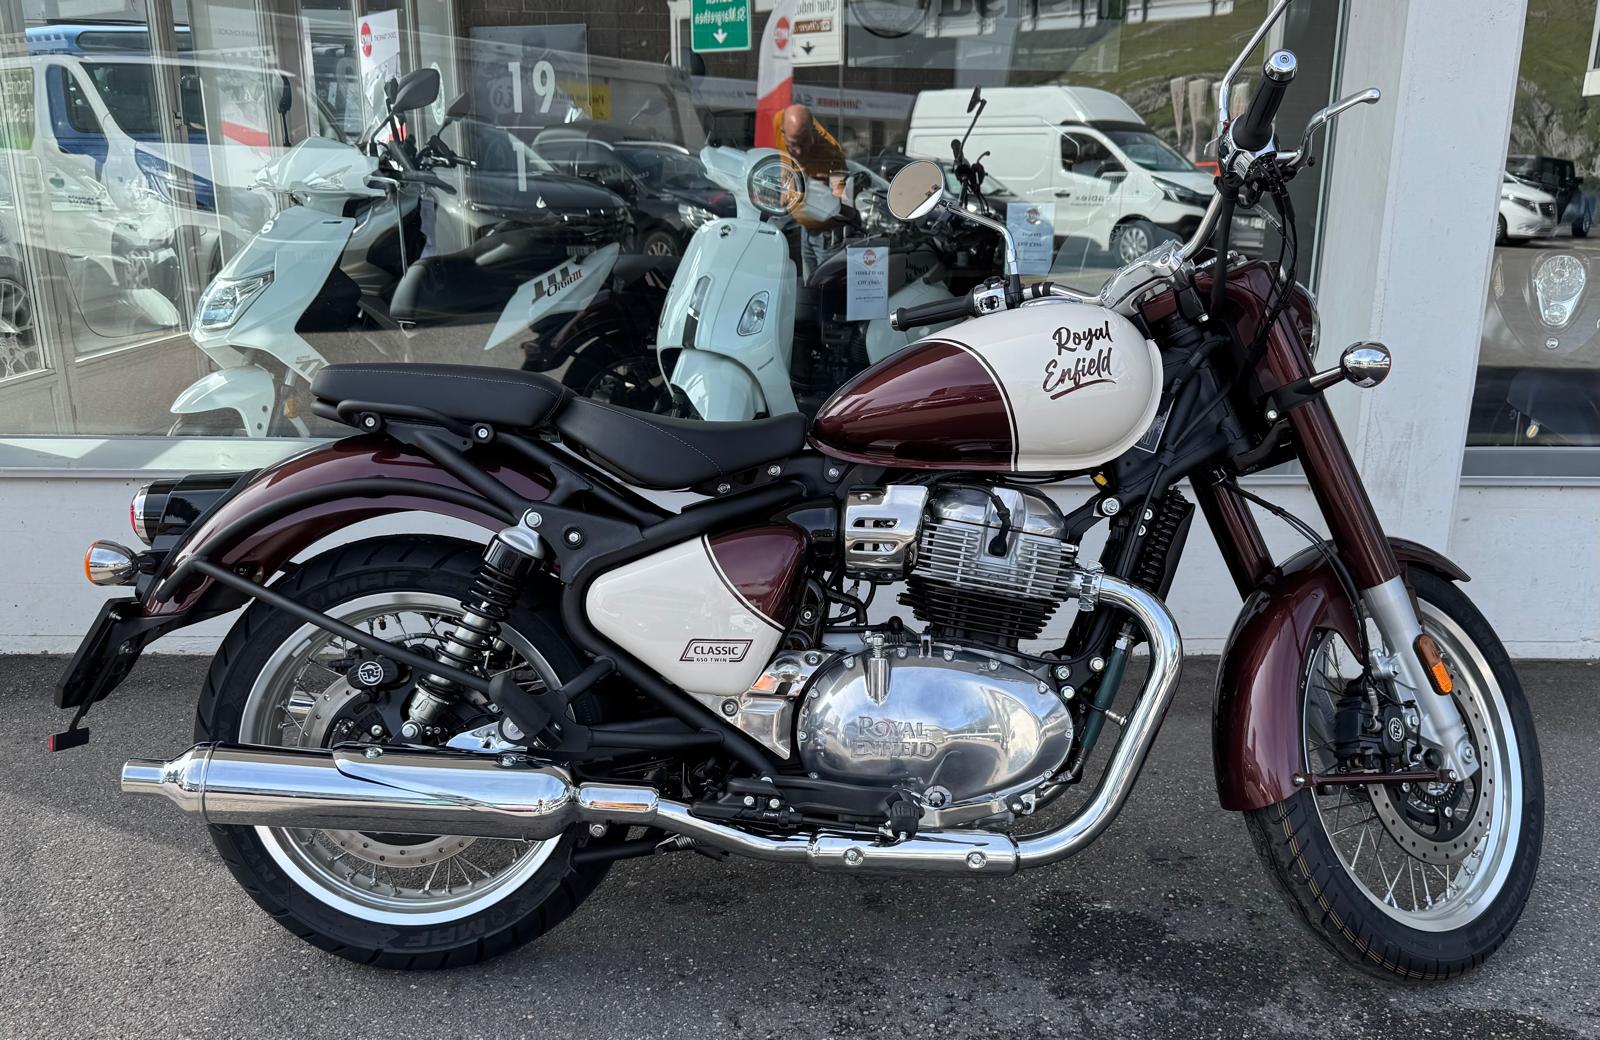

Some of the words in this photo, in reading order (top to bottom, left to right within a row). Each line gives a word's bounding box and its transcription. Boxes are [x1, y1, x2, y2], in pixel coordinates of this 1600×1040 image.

[508, 60, 556, 113] 19
[1052, 320, 1114, 356] Royal
[1042, 347, 1113, 393] Enfield
[693, 645, 739, 656] CLASSIC
[857, 716, 928, 739] ROYAL
[851, 740, 938, 760] ENFIELD
